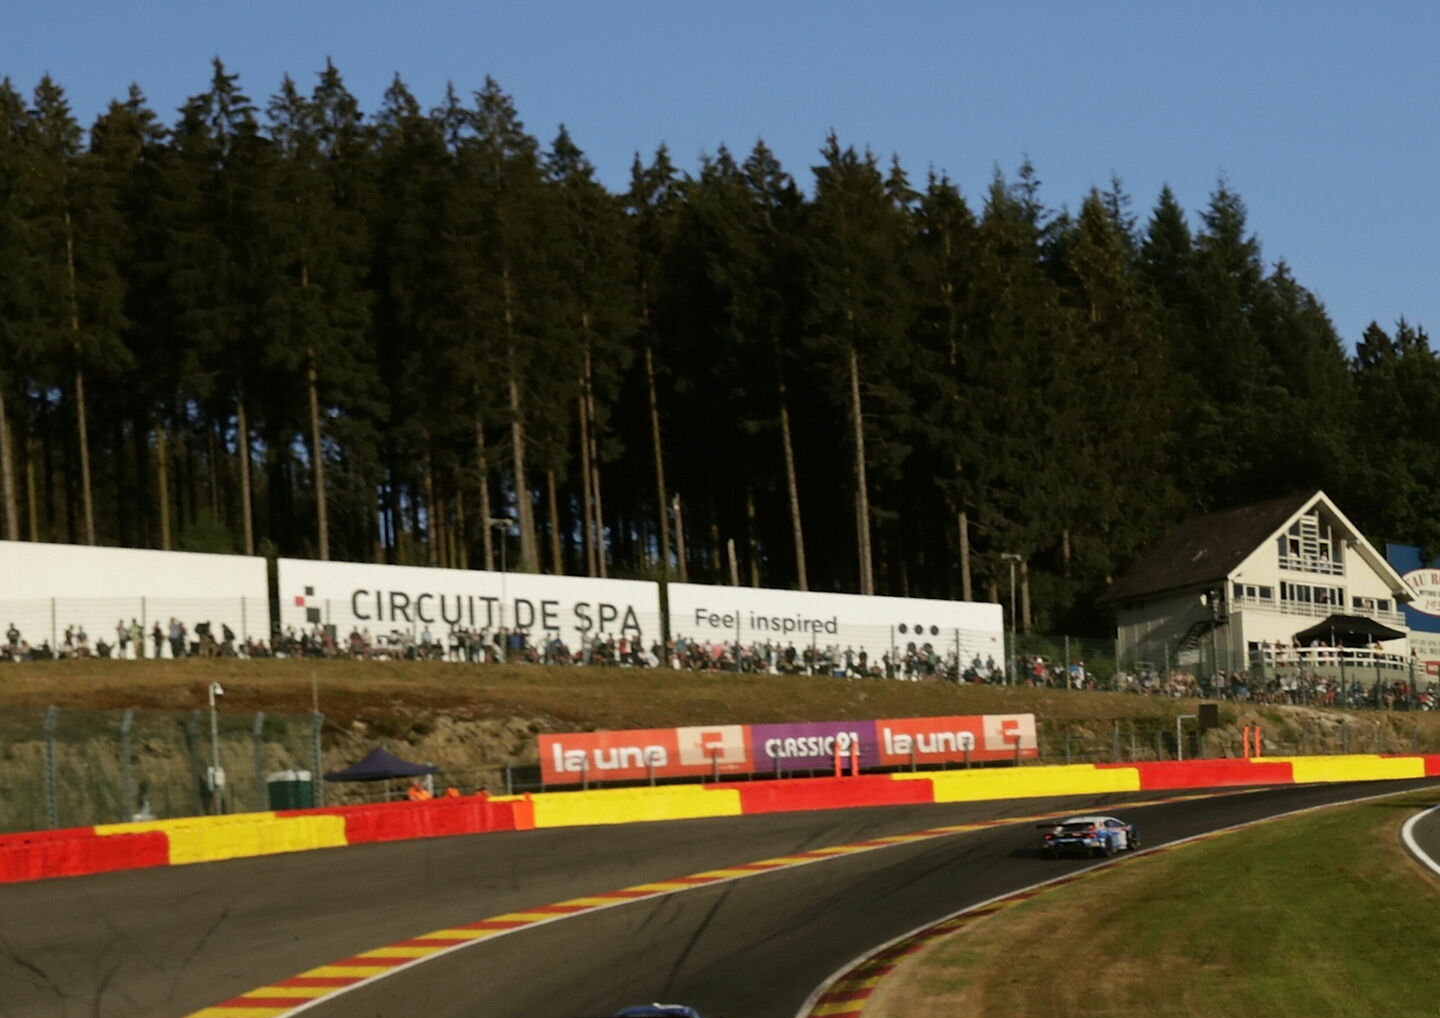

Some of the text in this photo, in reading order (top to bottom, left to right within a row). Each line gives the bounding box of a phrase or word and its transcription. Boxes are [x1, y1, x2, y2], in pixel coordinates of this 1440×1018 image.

[351, 589, 642, 635] CIRCUIT DE SPA
[750, 610, 838, 634] inspired
[764, 736, 835, 758] CLASSIC
[883, 727, 975, 755] la une
[552, 743, 668, 772] la une
